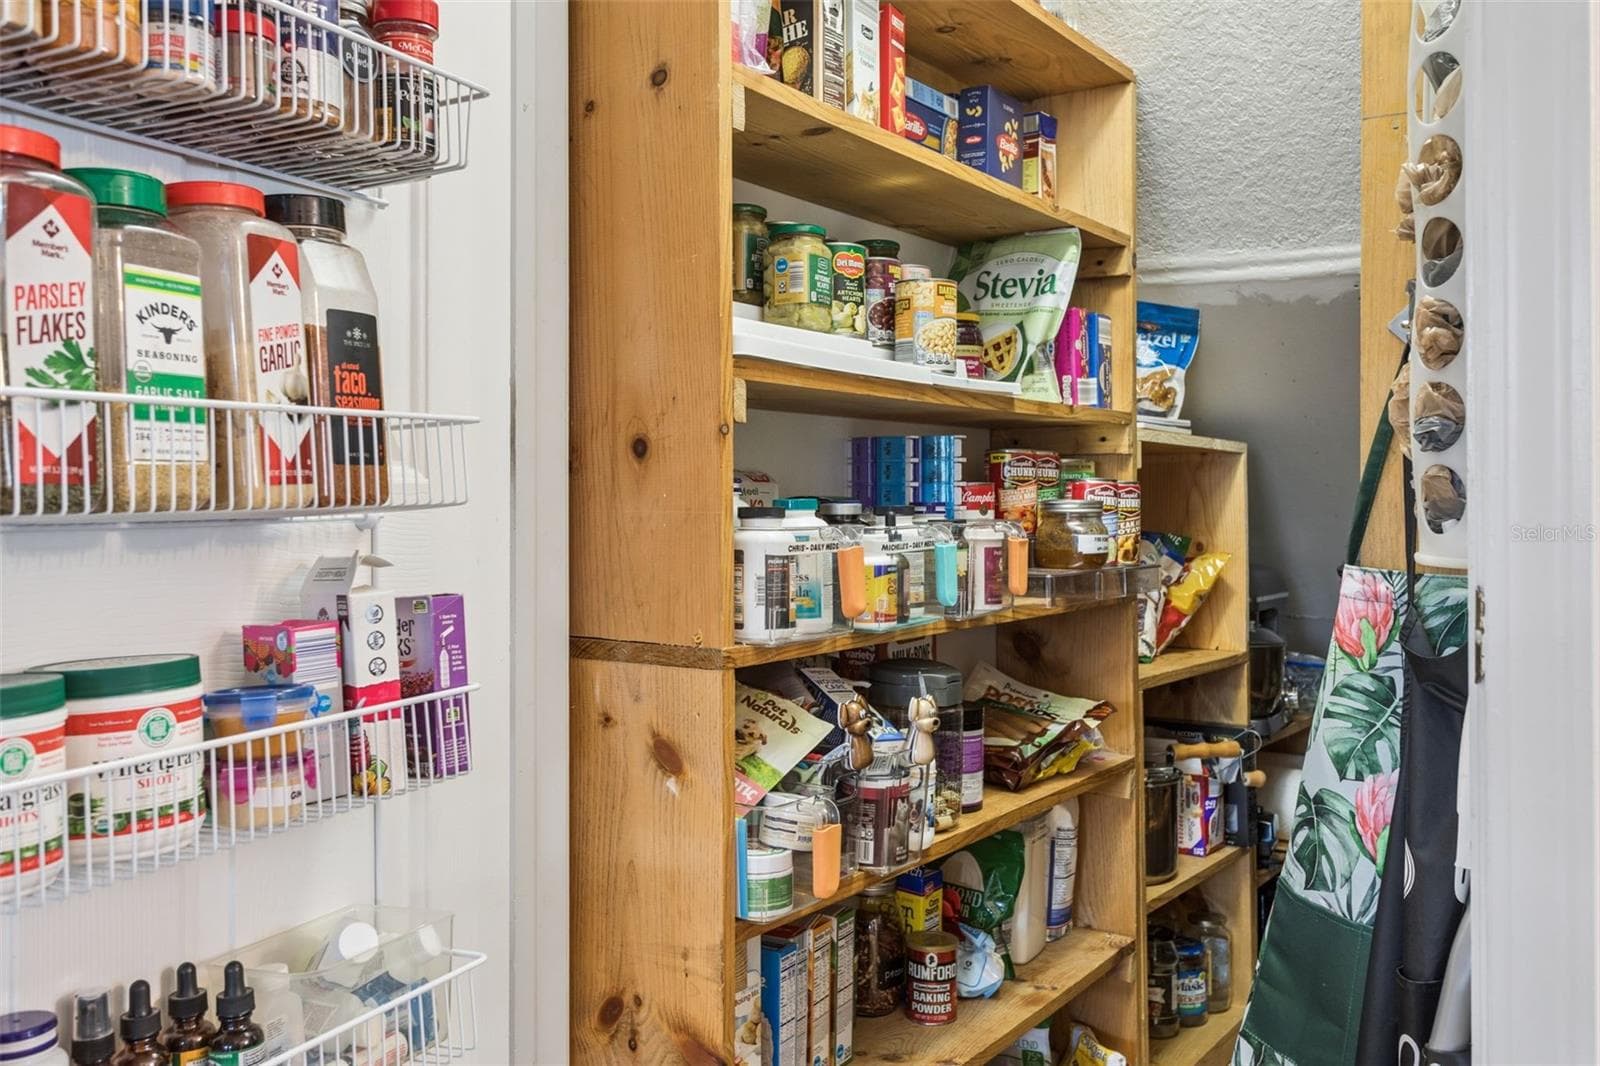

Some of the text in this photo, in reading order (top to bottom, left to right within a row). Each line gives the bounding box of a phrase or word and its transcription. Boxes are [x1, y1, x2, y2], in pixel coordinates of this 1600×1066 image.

[904, 117, 925, 136] arilla
[973, 268, 1057, 301] Stevia
[14, 281, 86, 311] PARSLEY
[136, 302, 198, 332] KINDER'S
[17, 312, 86, 345] FLAKES
[137, 349, 198, 363] SEASONING
[259, 340, 302, 373] GARLIC
[334, 364, 367, 395] taco
[135, 385, 200, 399] GARLIC SALT
[810, 543, 825, 551] DAILY
[741, 695, 801, 734] Naturals
[763, 699, 788, 716] Pet
[908, 961, 957, 981] RUMFORD
[913, 991, 951, 1003] BAKING
[912, 1002, 952, 1014] POWDER
